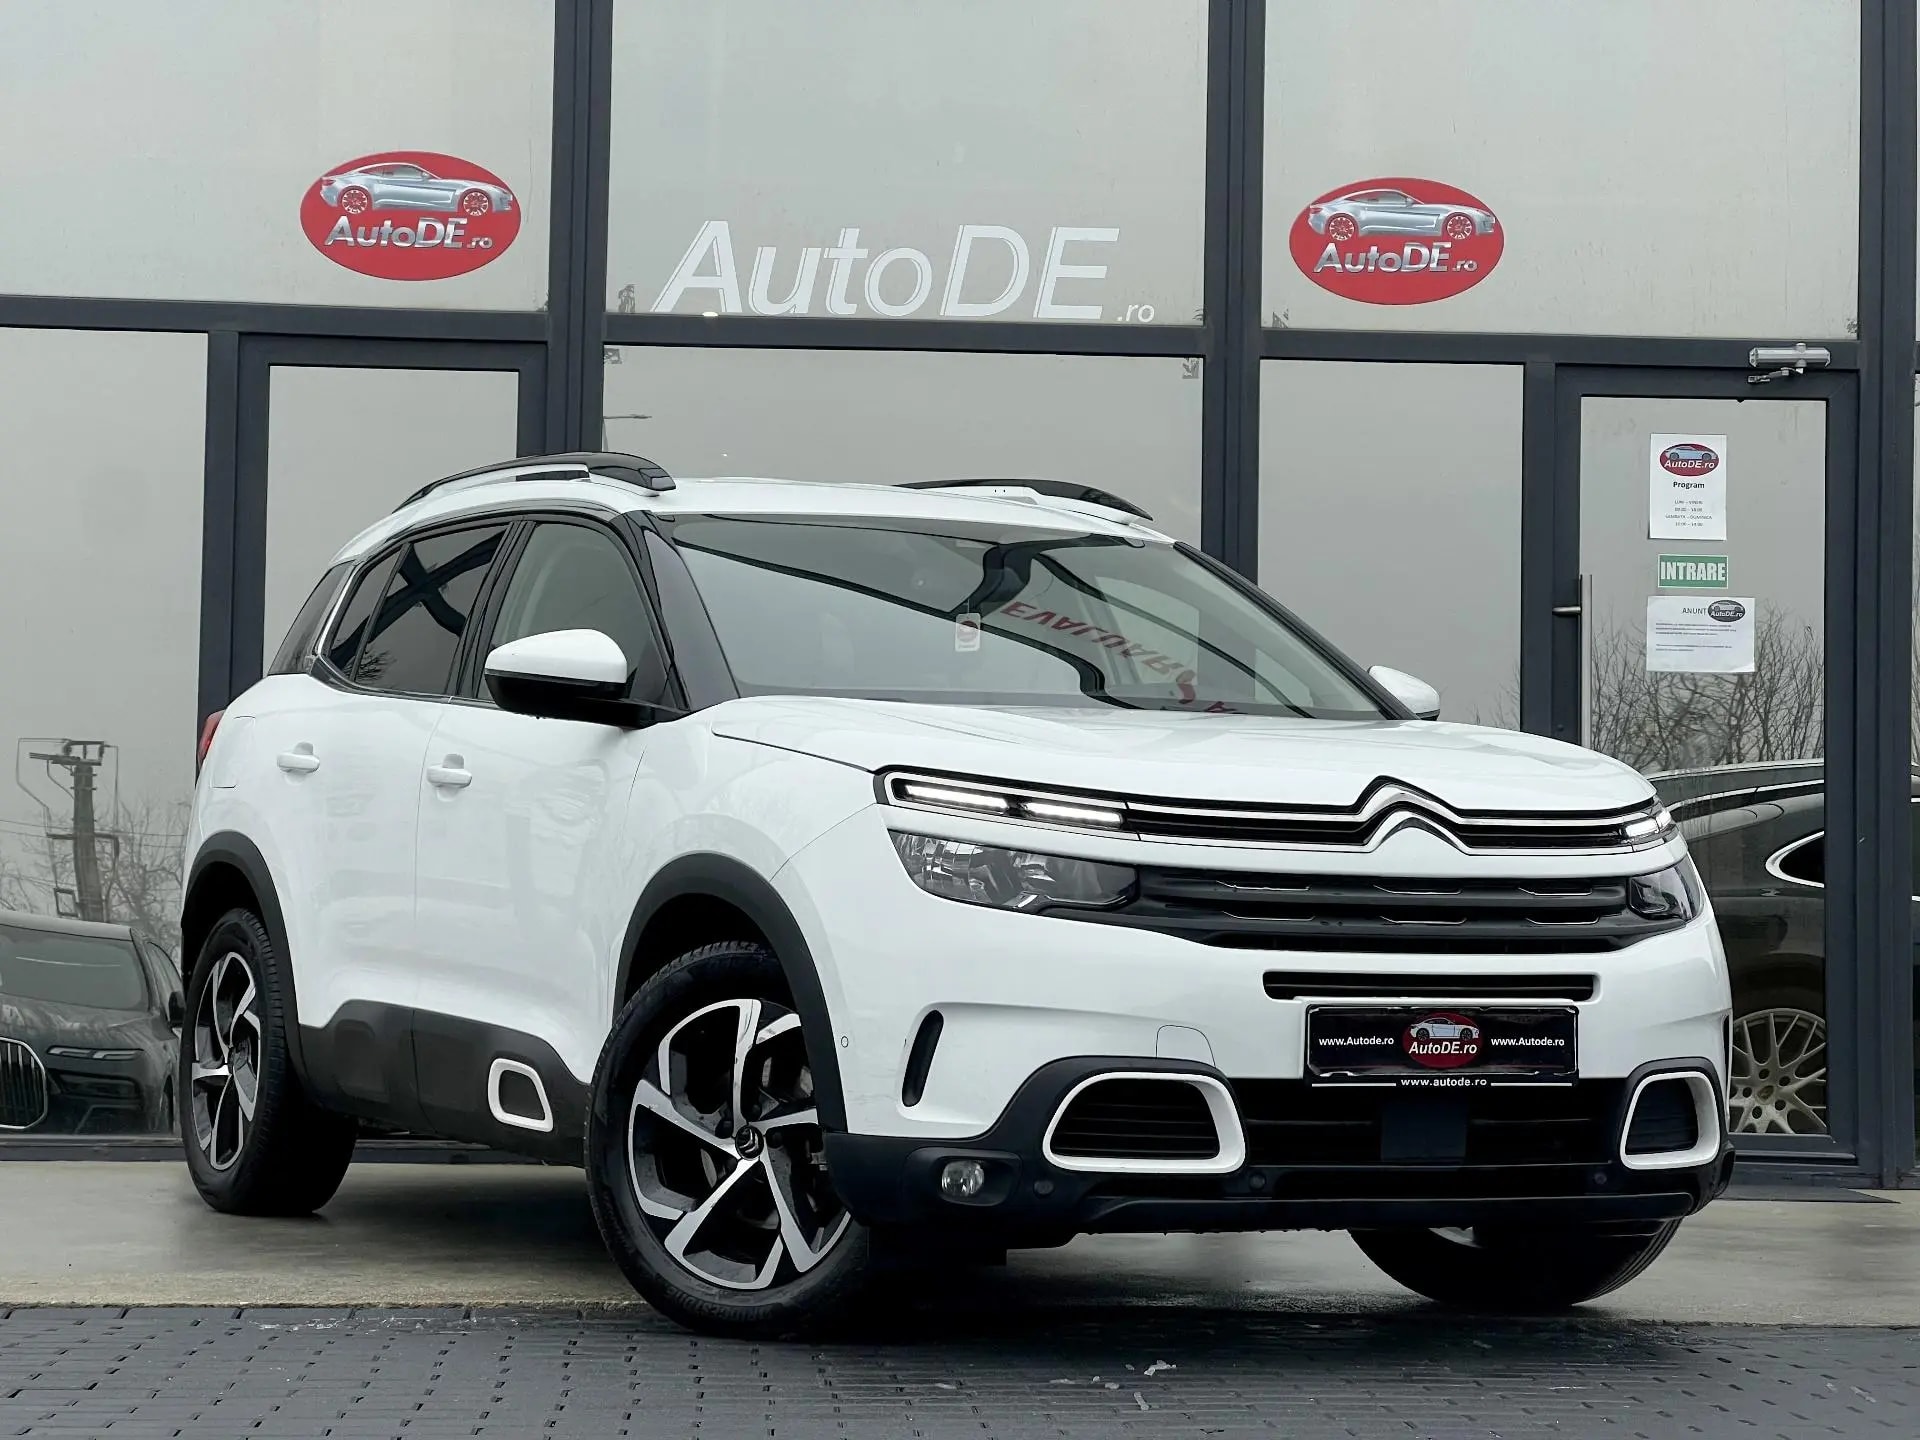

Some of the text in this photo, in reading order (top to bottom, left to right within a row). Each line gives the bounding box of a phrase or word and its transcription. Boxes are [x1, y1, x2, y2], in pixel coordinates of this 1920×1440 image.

[1664, 460, 1715, 469] AutoDE.ro
[1673, 481, 1705, 490] Program
[1660, 561, 1726, 581] INTRARE
[1319, 1036, 1394, 1046] www.Autode.ro
[1490, 1036, 1565, 1047] www.Autode.ro
[1409, 1041, 1477, 1055] AutoDE.ro
[1401, 1077, 1487, 1087] www.autode.ro
